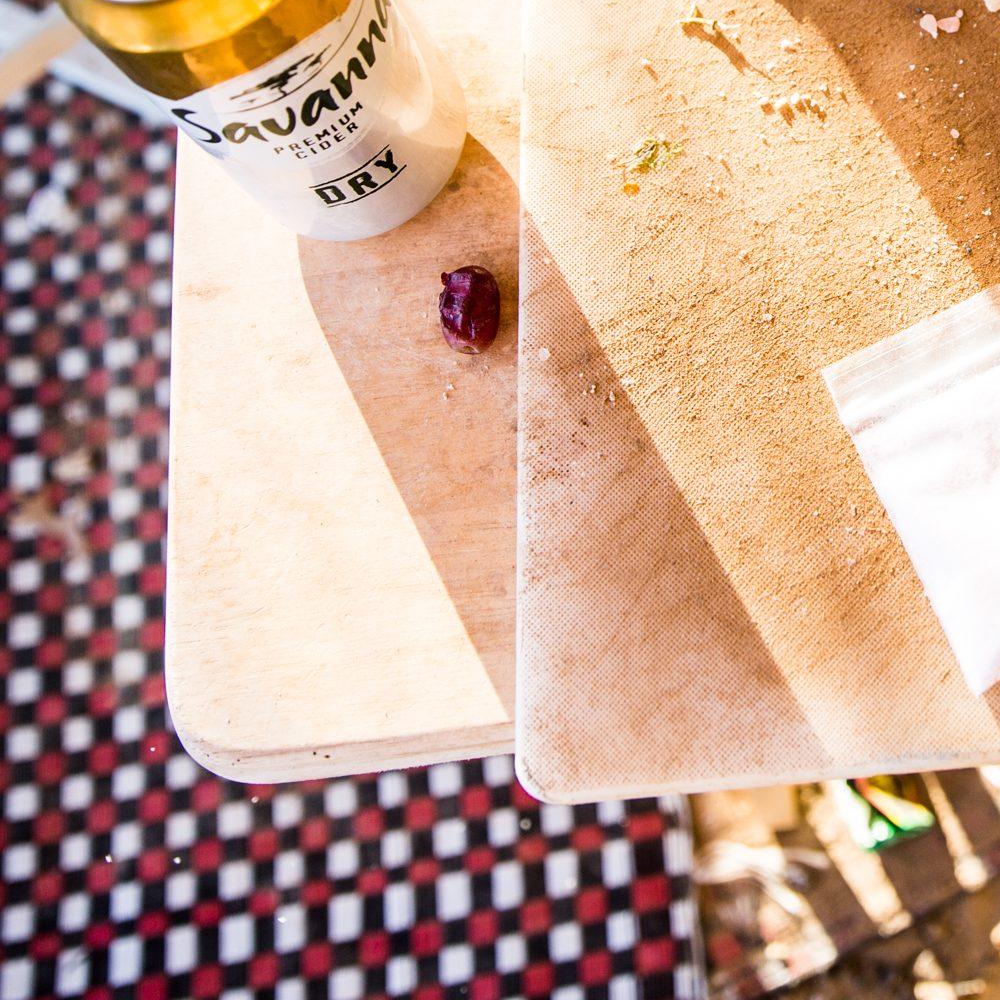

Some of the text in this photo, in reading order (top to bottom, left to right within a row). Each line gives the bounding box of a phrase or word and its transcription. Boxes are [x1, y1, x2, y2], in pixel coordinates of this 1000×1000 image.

[274, 101, 363, 155] PREMIUM
[295, 122, 359, 160] CIDER
[314, 149, 398, 205] DRY
